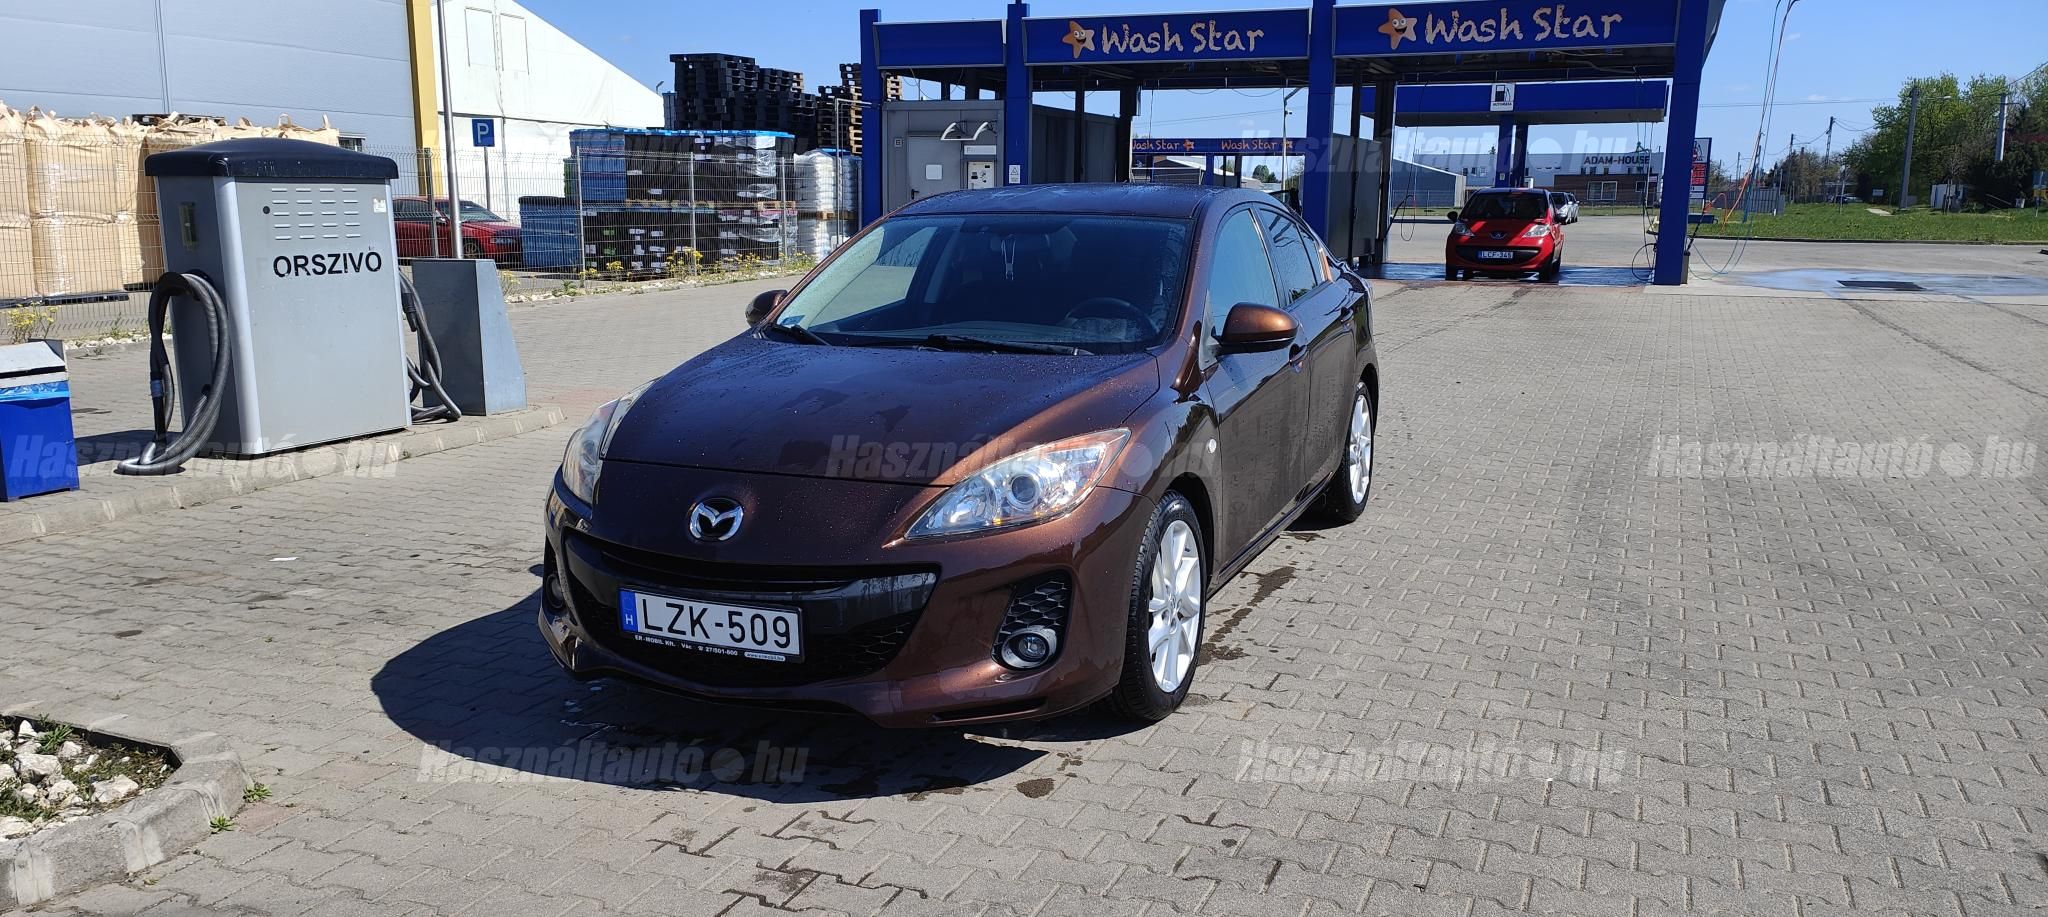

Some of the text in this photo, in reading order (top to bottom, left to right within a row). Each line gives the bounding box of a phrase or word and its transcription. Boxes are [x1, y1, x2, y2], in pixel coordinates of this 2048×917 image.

[1424, 4, 1623, 44] Wash Star
[1102, 19, 1264, 54] Wash Star
[477, 123, 490, 144] P
[1156, 139, 1180, 150] Star
[1221, 139, 1278, 150] Wash Star
[1584, 155, 1651, 165] ADAM-HOUSE
[642, 598, 791, 649] LZK-509
